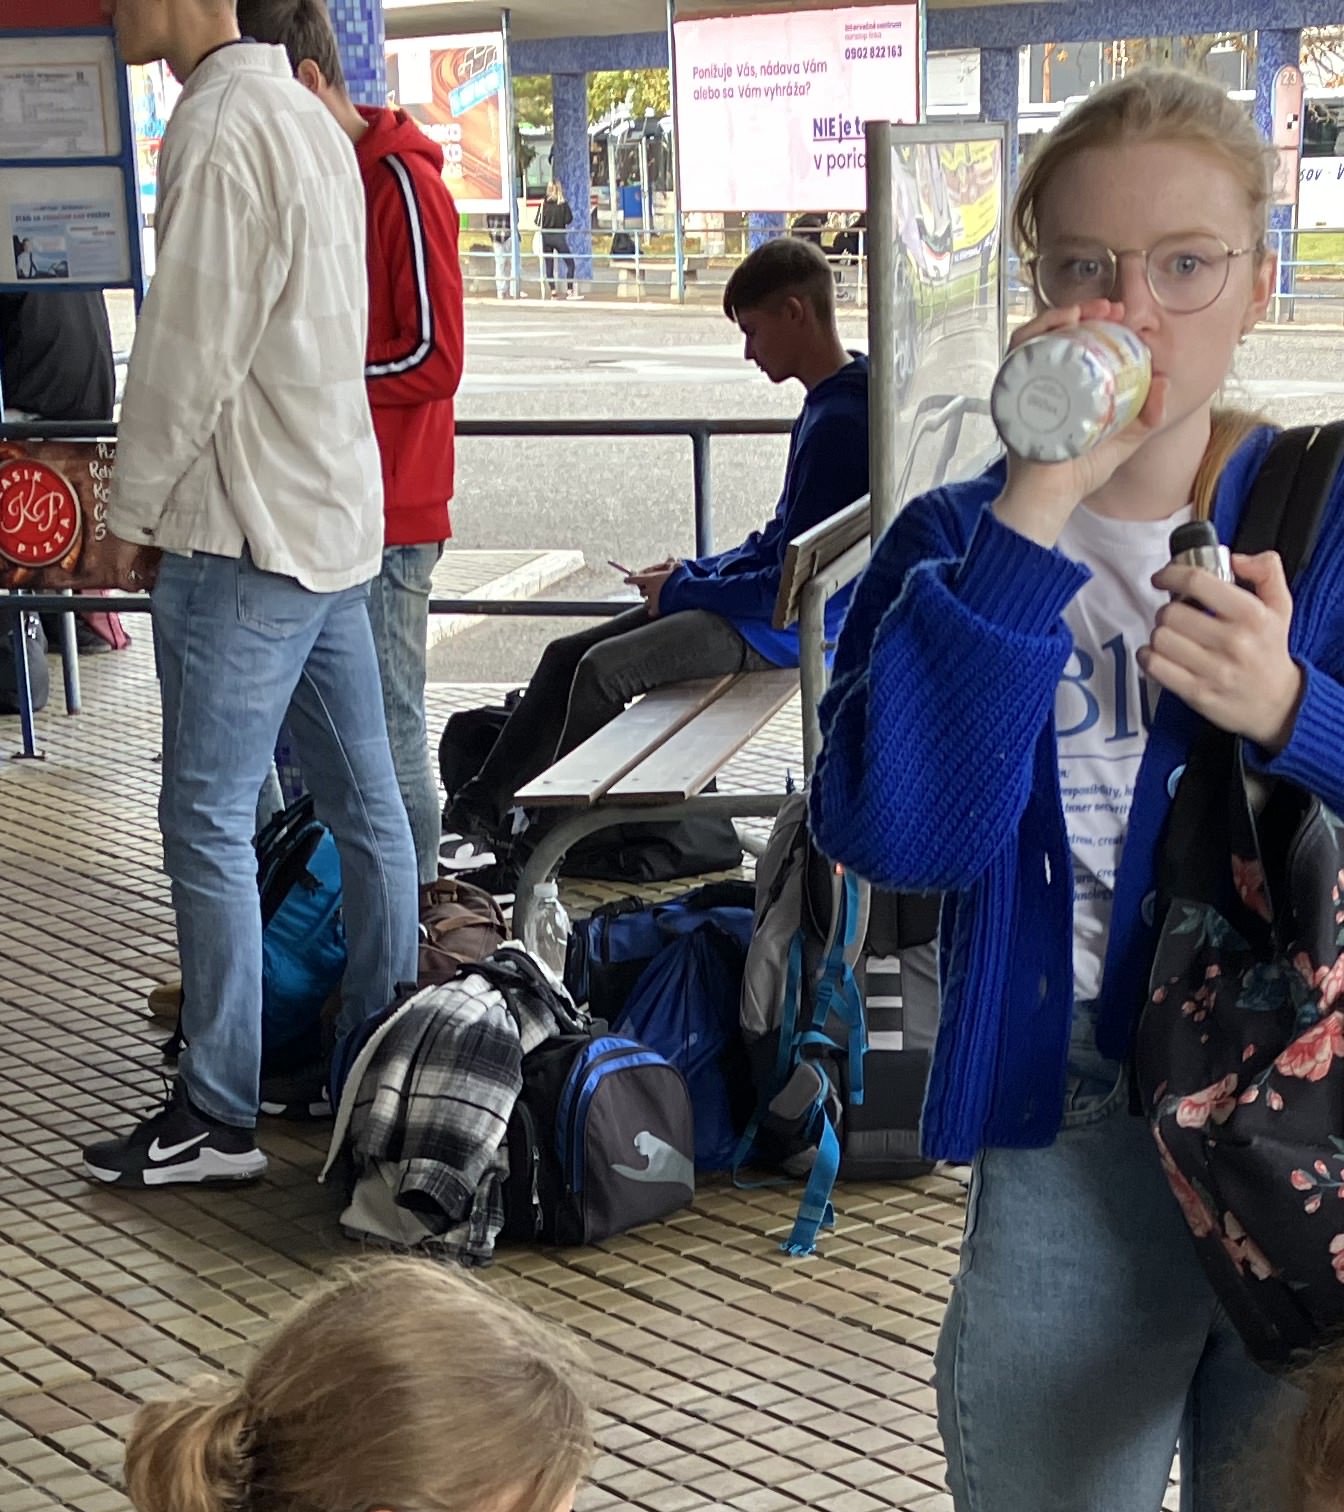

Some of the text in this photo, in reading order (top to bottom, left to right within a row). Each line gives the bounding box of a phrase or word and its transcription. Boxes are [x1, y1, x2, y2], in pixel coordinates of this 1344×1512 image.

[844, 44, 903, 60] 0902 822 163
[737, 61, 758, 78] Vás,
[760, 60, 800, 77] nádava
[802, 58, 828, 75] Vám
[693, 81, 811, 102] alebo sa Vám vyhráža?
[813, 116, 836, 138] NIE
[838, 112, 852, 144] je
[813, 153, 823, 171] v
[17, 517, 71, 557] PIZZA
